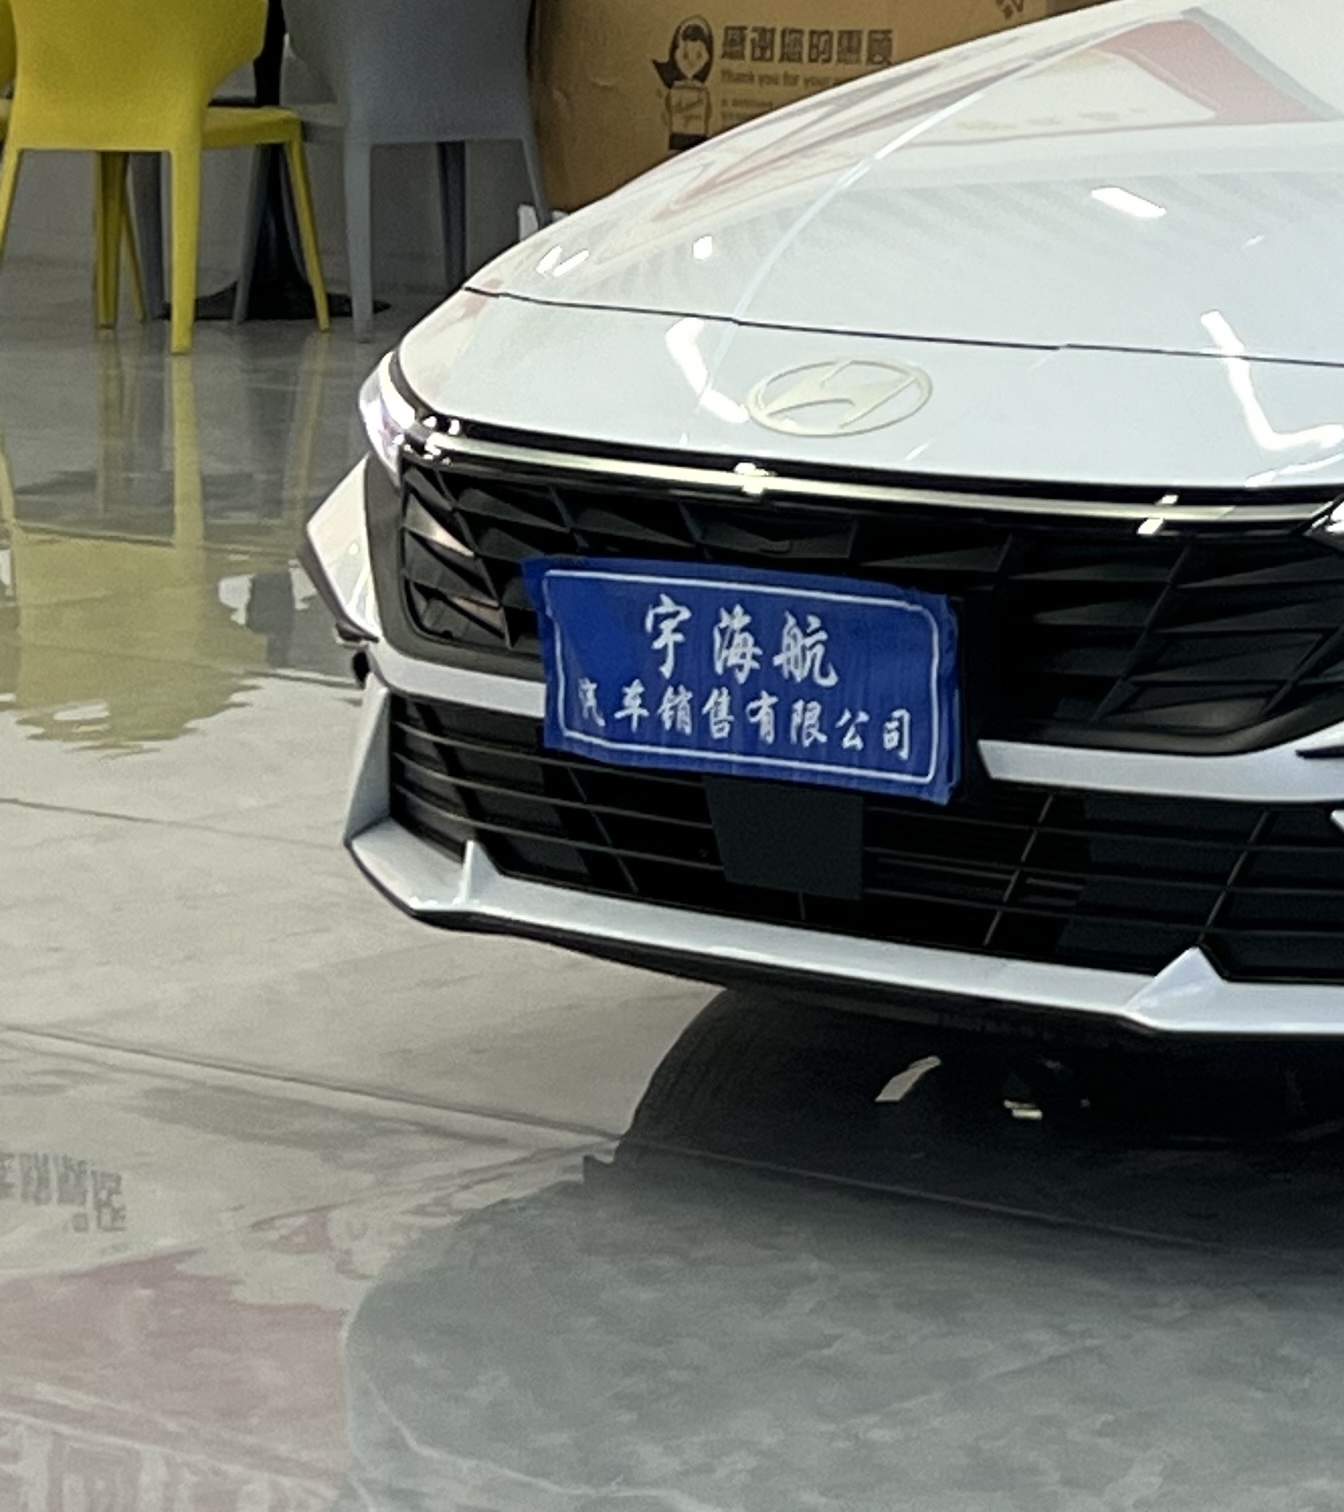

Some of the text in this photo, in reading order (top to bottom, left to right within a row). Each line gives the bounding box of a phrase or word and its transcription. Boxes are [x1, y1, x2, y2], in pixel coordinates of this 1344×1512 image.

[644, 593, 839, 687] 宇海航
[576, 677, 913, 761] 汽车销售有限公司
